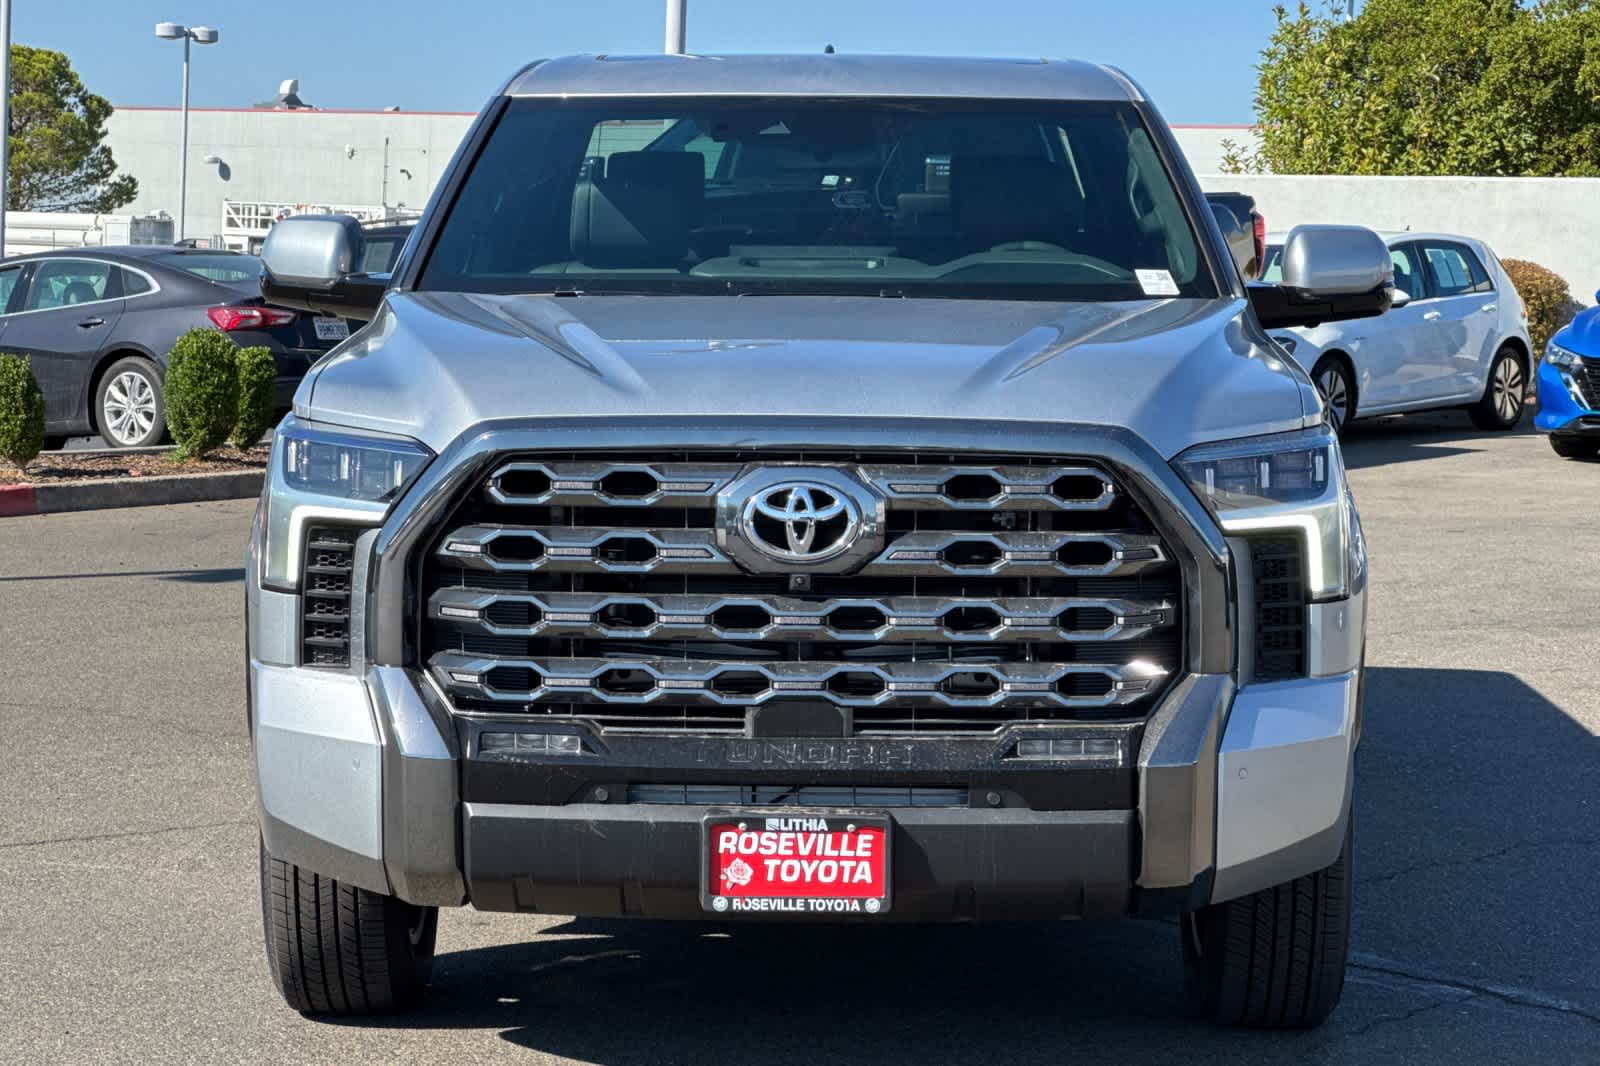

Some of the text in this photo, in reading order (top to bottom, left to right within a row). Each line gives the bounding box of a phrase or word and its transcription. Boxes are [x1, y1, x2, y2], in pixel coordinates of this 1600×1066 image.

[779, 818, 829, 832] LITHIA
[718, 831, 874, 857] ROSEVILLE
[763, 858, 873, 884] TOYOTA
[732, 898, 861, 911] ROSEVILLE TOYOTA
